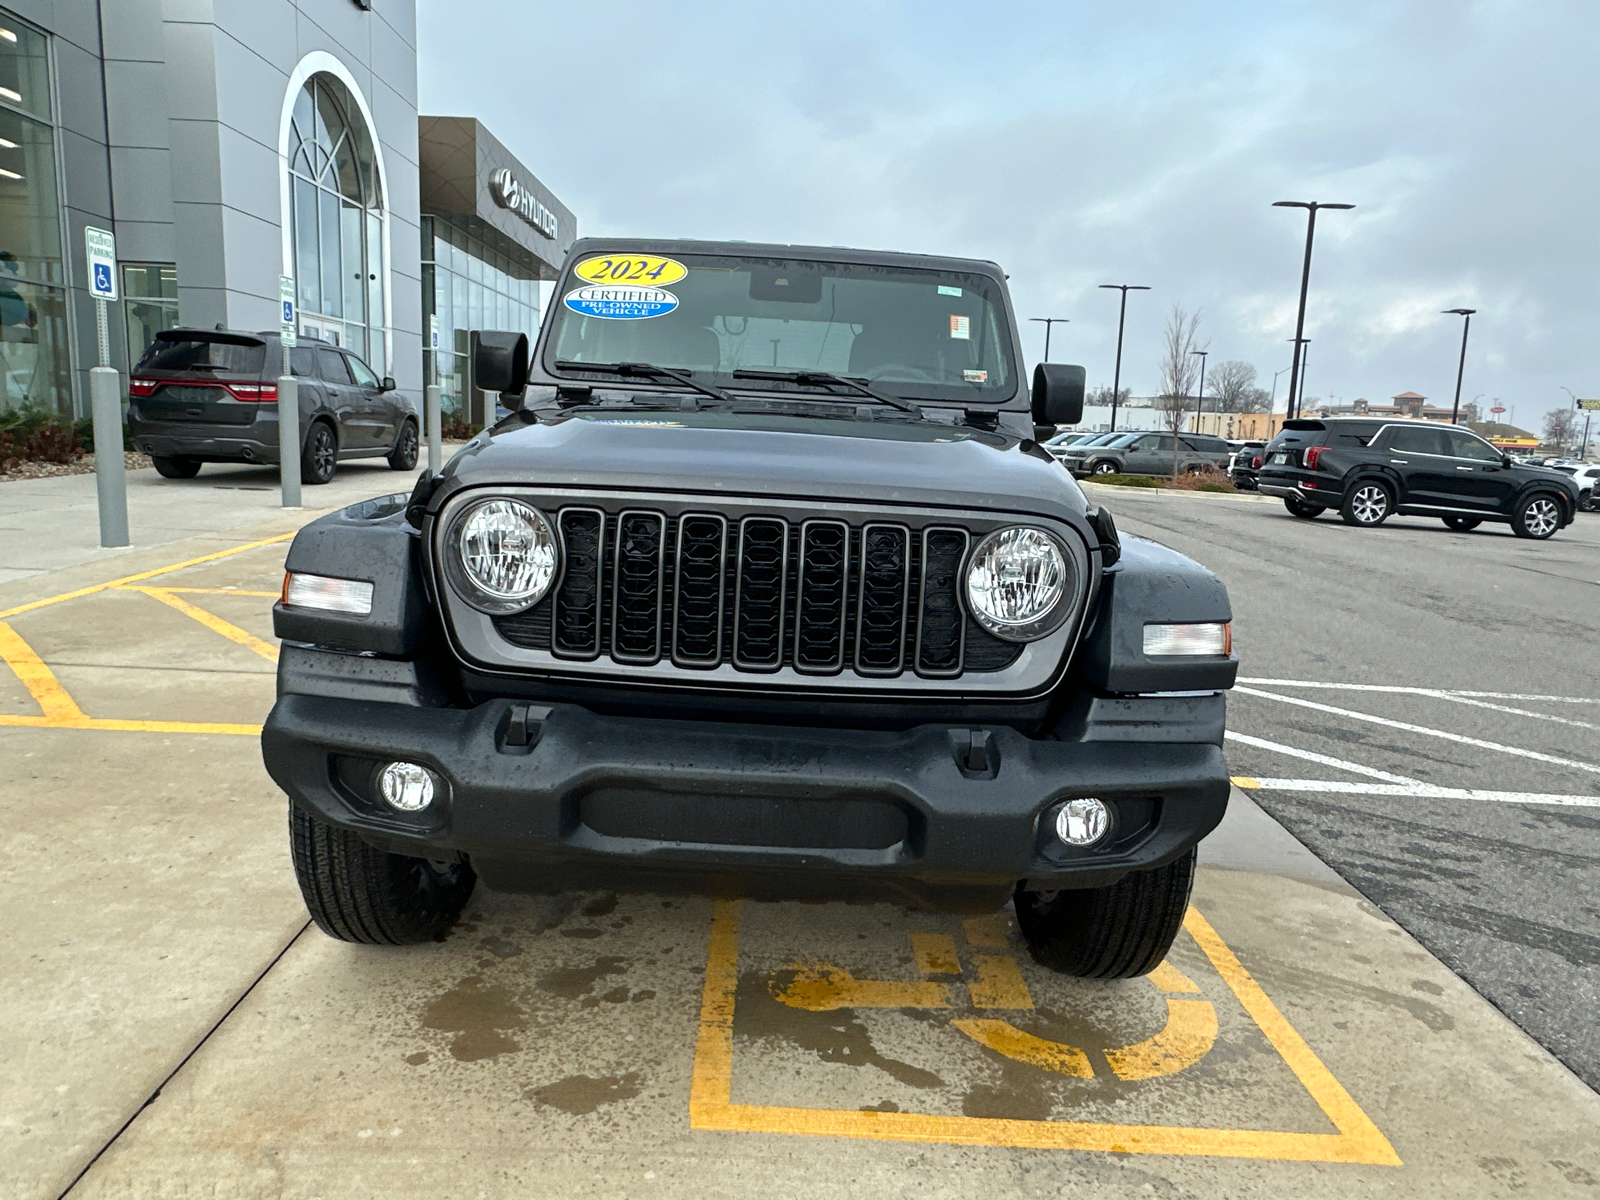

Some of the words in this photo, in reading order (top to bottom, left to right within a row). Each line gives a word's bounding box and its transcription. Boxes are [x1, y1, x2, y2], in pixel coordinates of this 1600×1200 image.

[521, 186, 557, 240] HYUNDAI
[89, 246, 113, 260] PARKING
[590, 260, 668, 280] 2024
[578, 289, 666, 302] CERTIFIED
[581, 301, 661, 310] PRE-OWNED
[592, 307, 649, 316] VEHICLE
